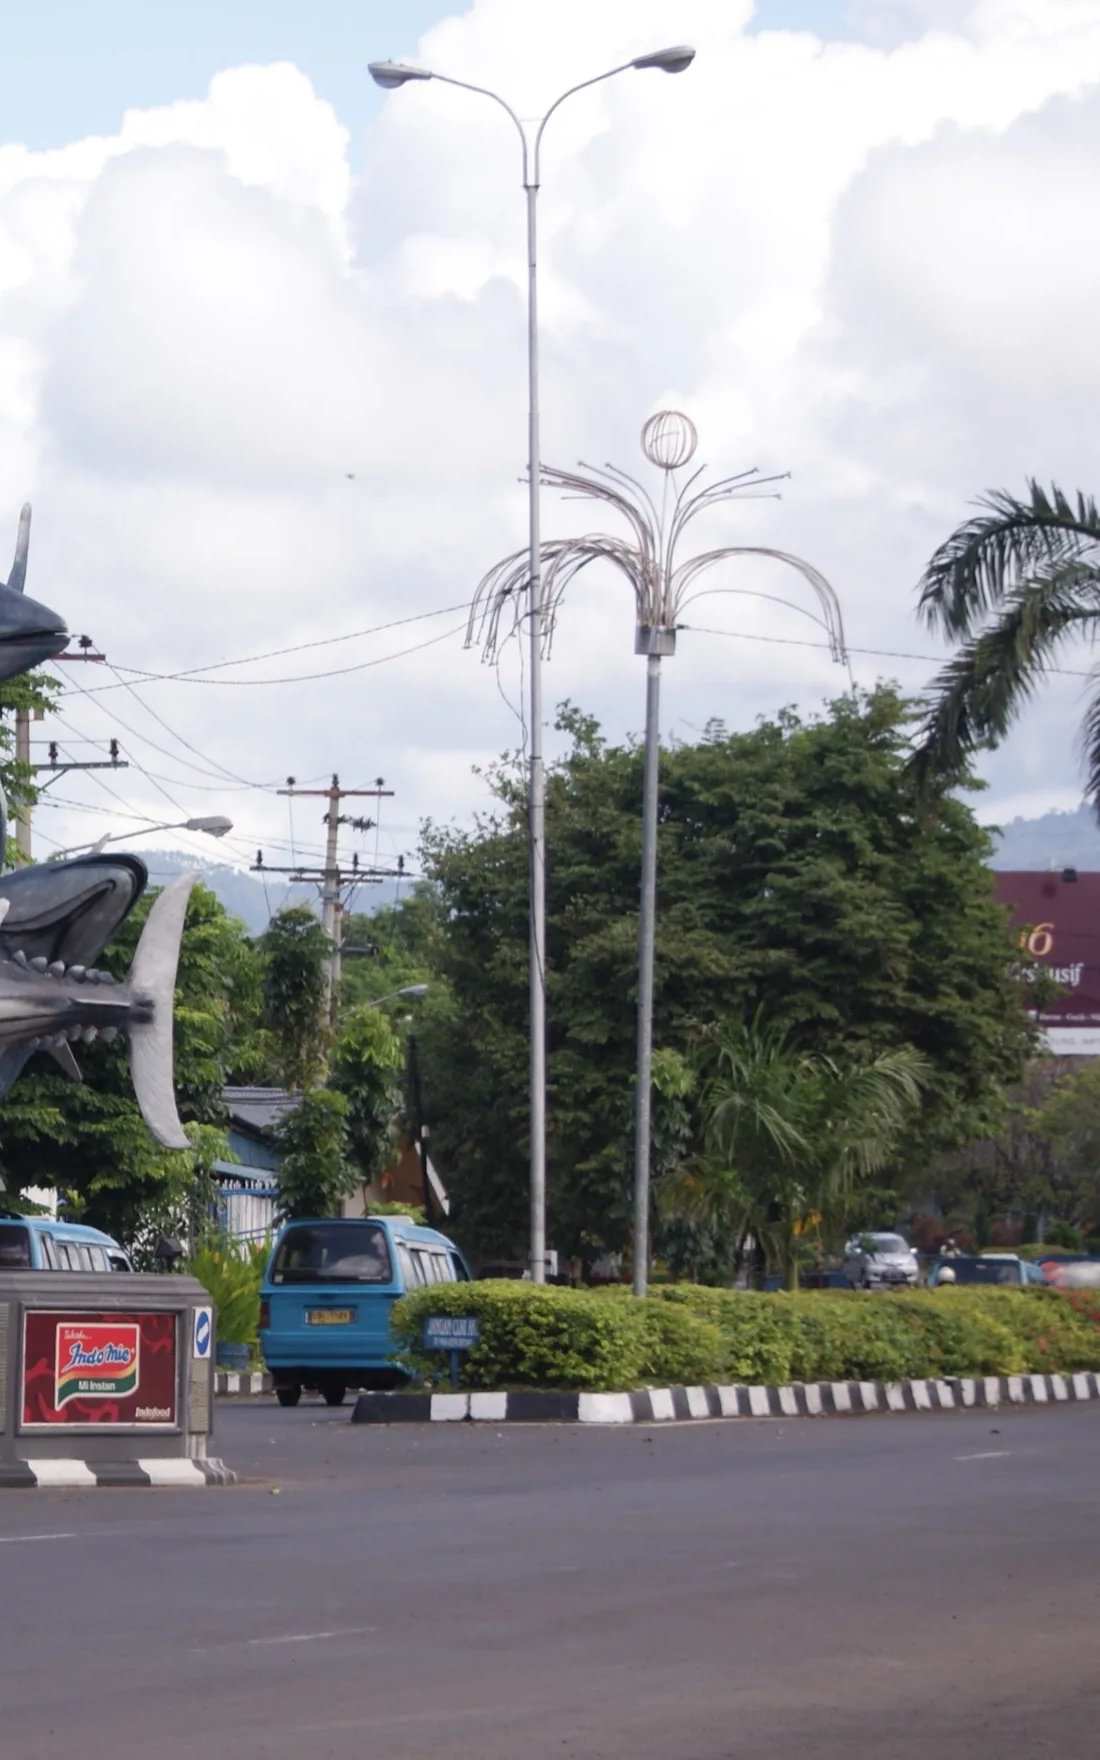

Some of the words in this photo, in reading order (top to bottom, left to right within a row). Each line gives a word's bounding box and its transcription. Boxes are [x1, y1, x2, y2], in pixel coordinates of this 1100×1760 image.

[78, 1381, 88, 1390] Mi
[90, 1381, 116, 1390] Instan
[135, 1407, 171, 1418] Indofood
